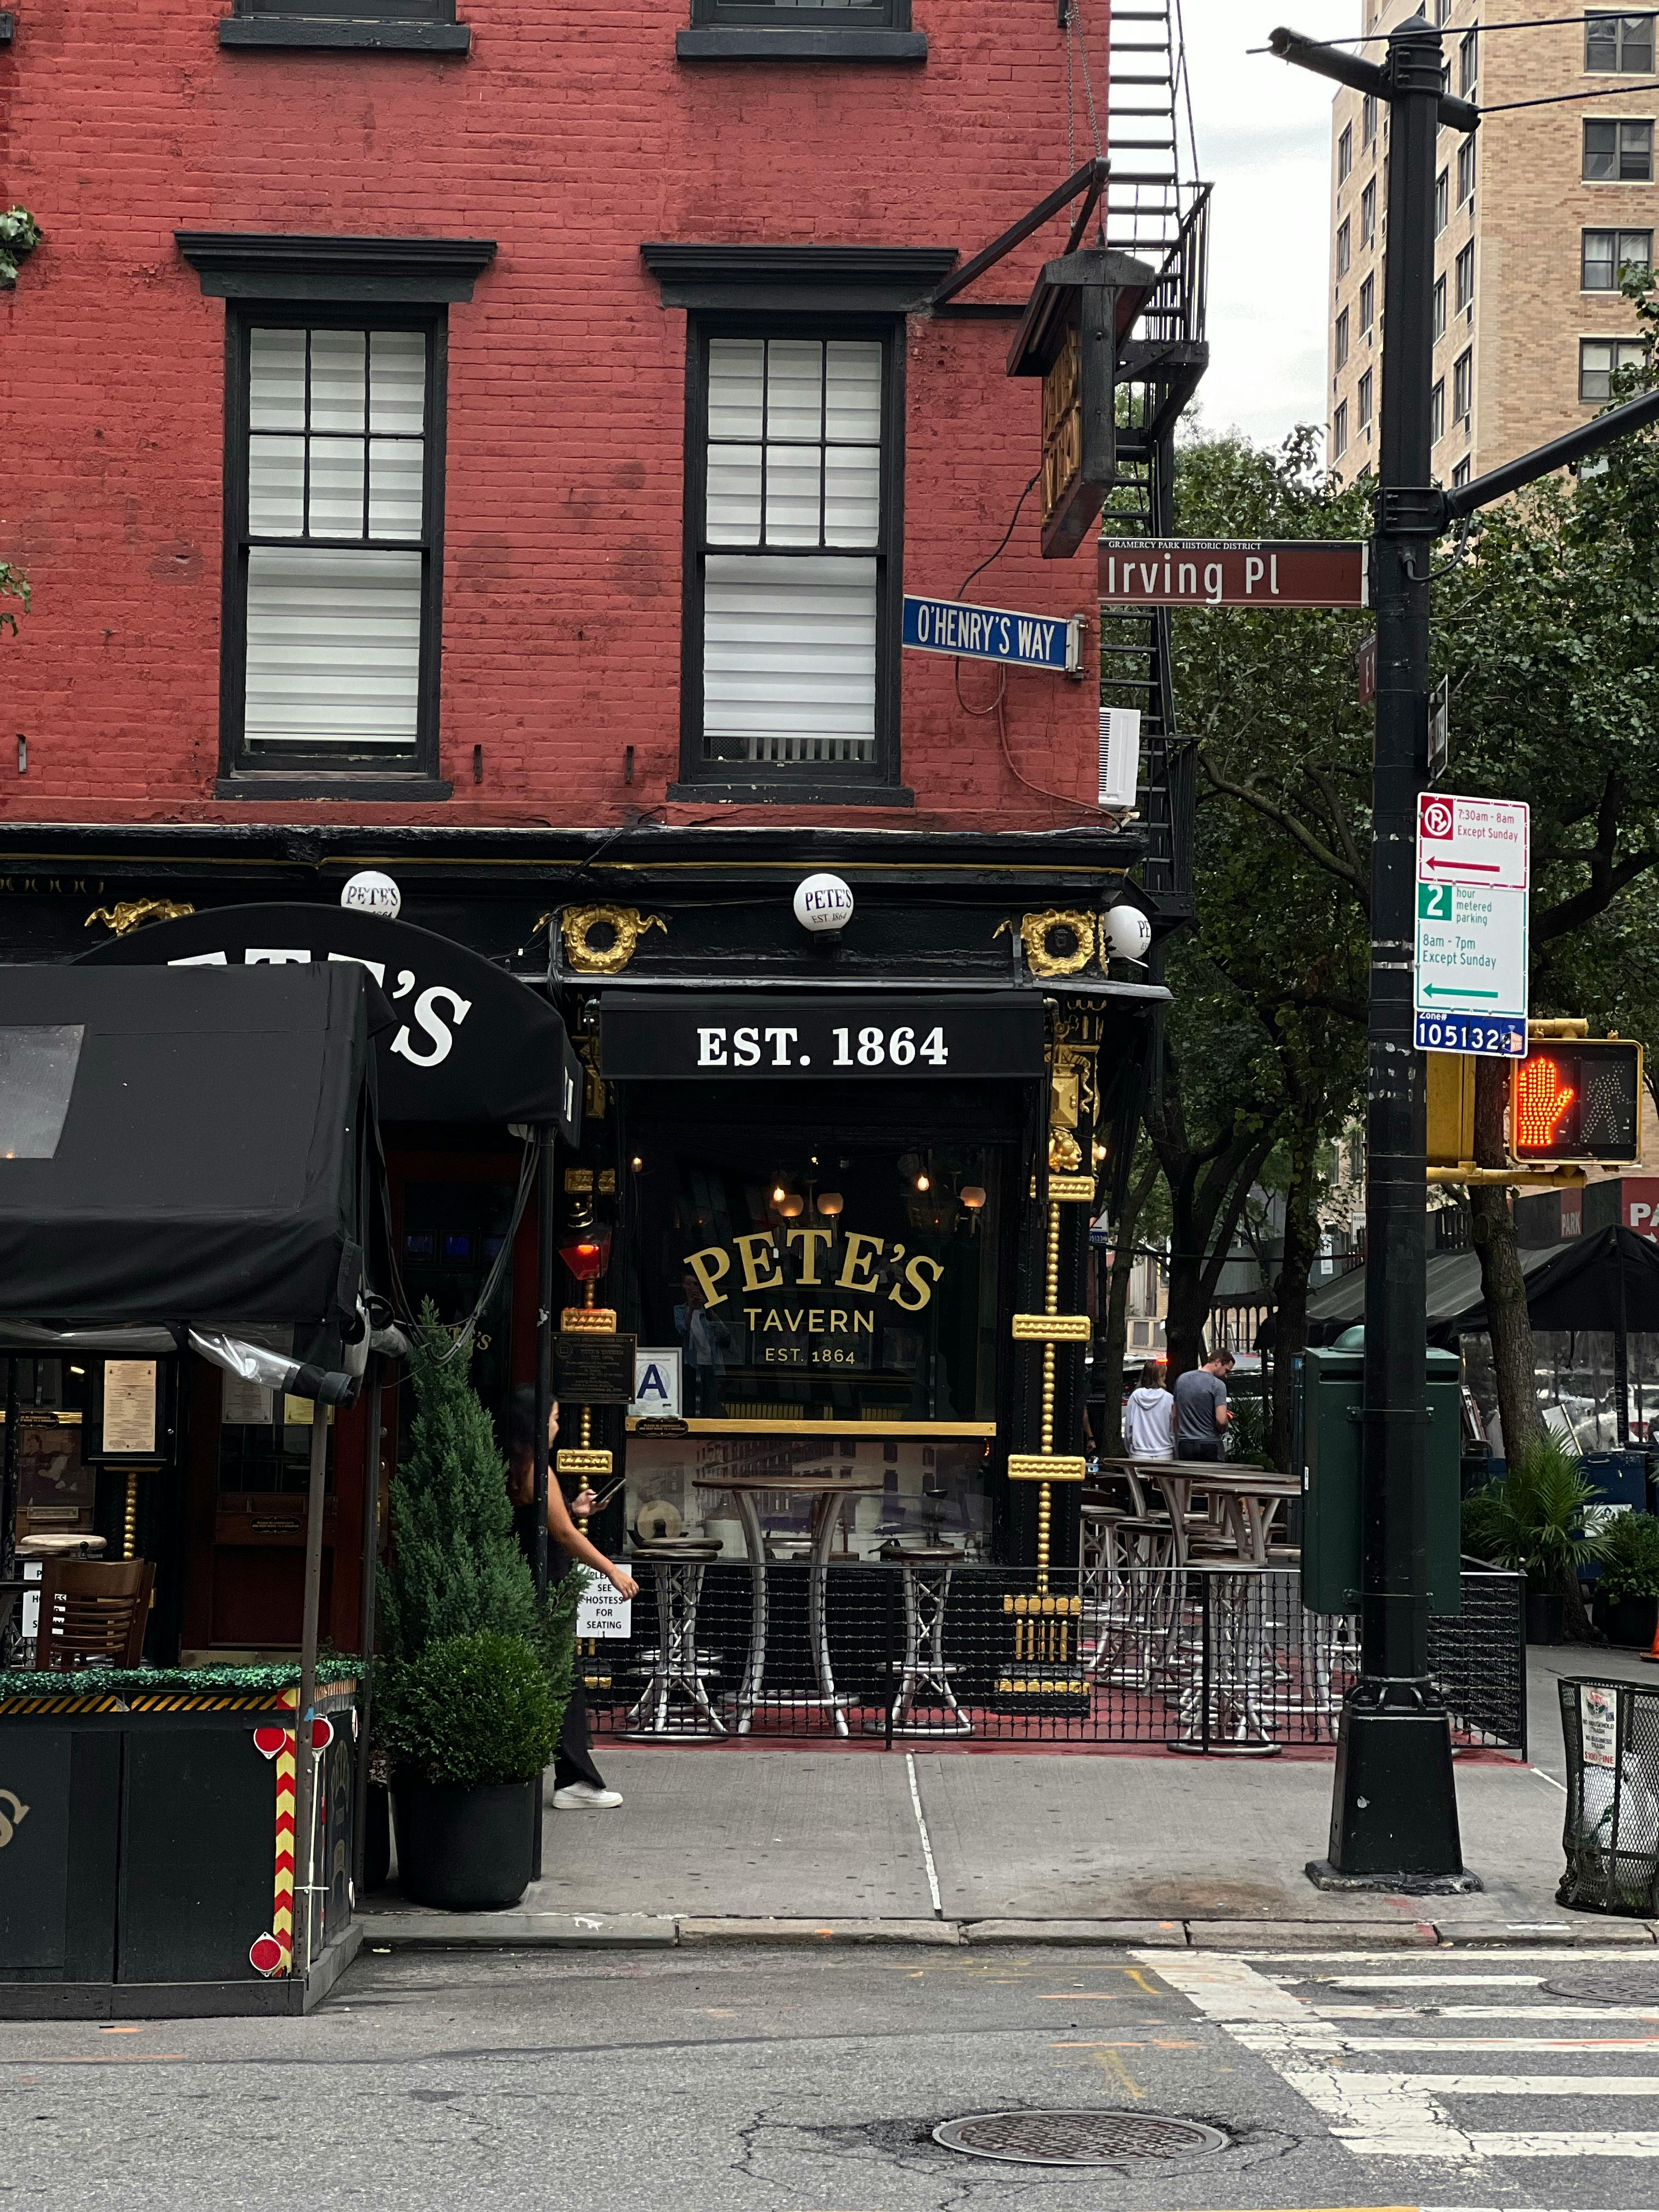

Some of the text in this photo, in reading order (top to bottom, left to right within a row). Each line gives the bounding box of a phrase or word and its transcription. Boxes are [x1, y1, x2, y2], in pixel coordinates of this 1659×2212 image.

[1109, 552, 1279, 604] Irving Pl
[918, 605, 1054, 661] O'HENRY'S WAY
[1458, 809, 1488, 822] 7:30am
[1497, 813, 1514, 824] 8am
[1458, 826, 1518, 842] Except Sunday
[346, 886, 398, 906] PETE'S
[805, 889, 851, 911] PETE'S
[1427, 885, 1443, 916] 2
[1457, 887, 1476, 898] hour
[1457, 900, 1492, 912] metered
[833, 913, 847, 922] 1864
[1457, 913, 1487, 926] parking
[1423, 934, 1444, 947] 8am
[1455, 936, 1475, 951] 7pm
[1423, 950, 1497, 970] Except Sunday
[1419, 1012, 1448, 1021] Zone#
[697, 1027, 949, 1066] EST. 1864
[1419, 1023, 1499, 1050] 105132
[1562, 1211, 1581, 1237] PARK
[684, 1229, 944, 1311] PETE'S
[743, 1308, 873, 1333] TAVERN
[765, 1348, 855, 1364] EST. 1864
[636, 1364, 668, 1398] A
[1584, 1751, 1598, 1761] $100
